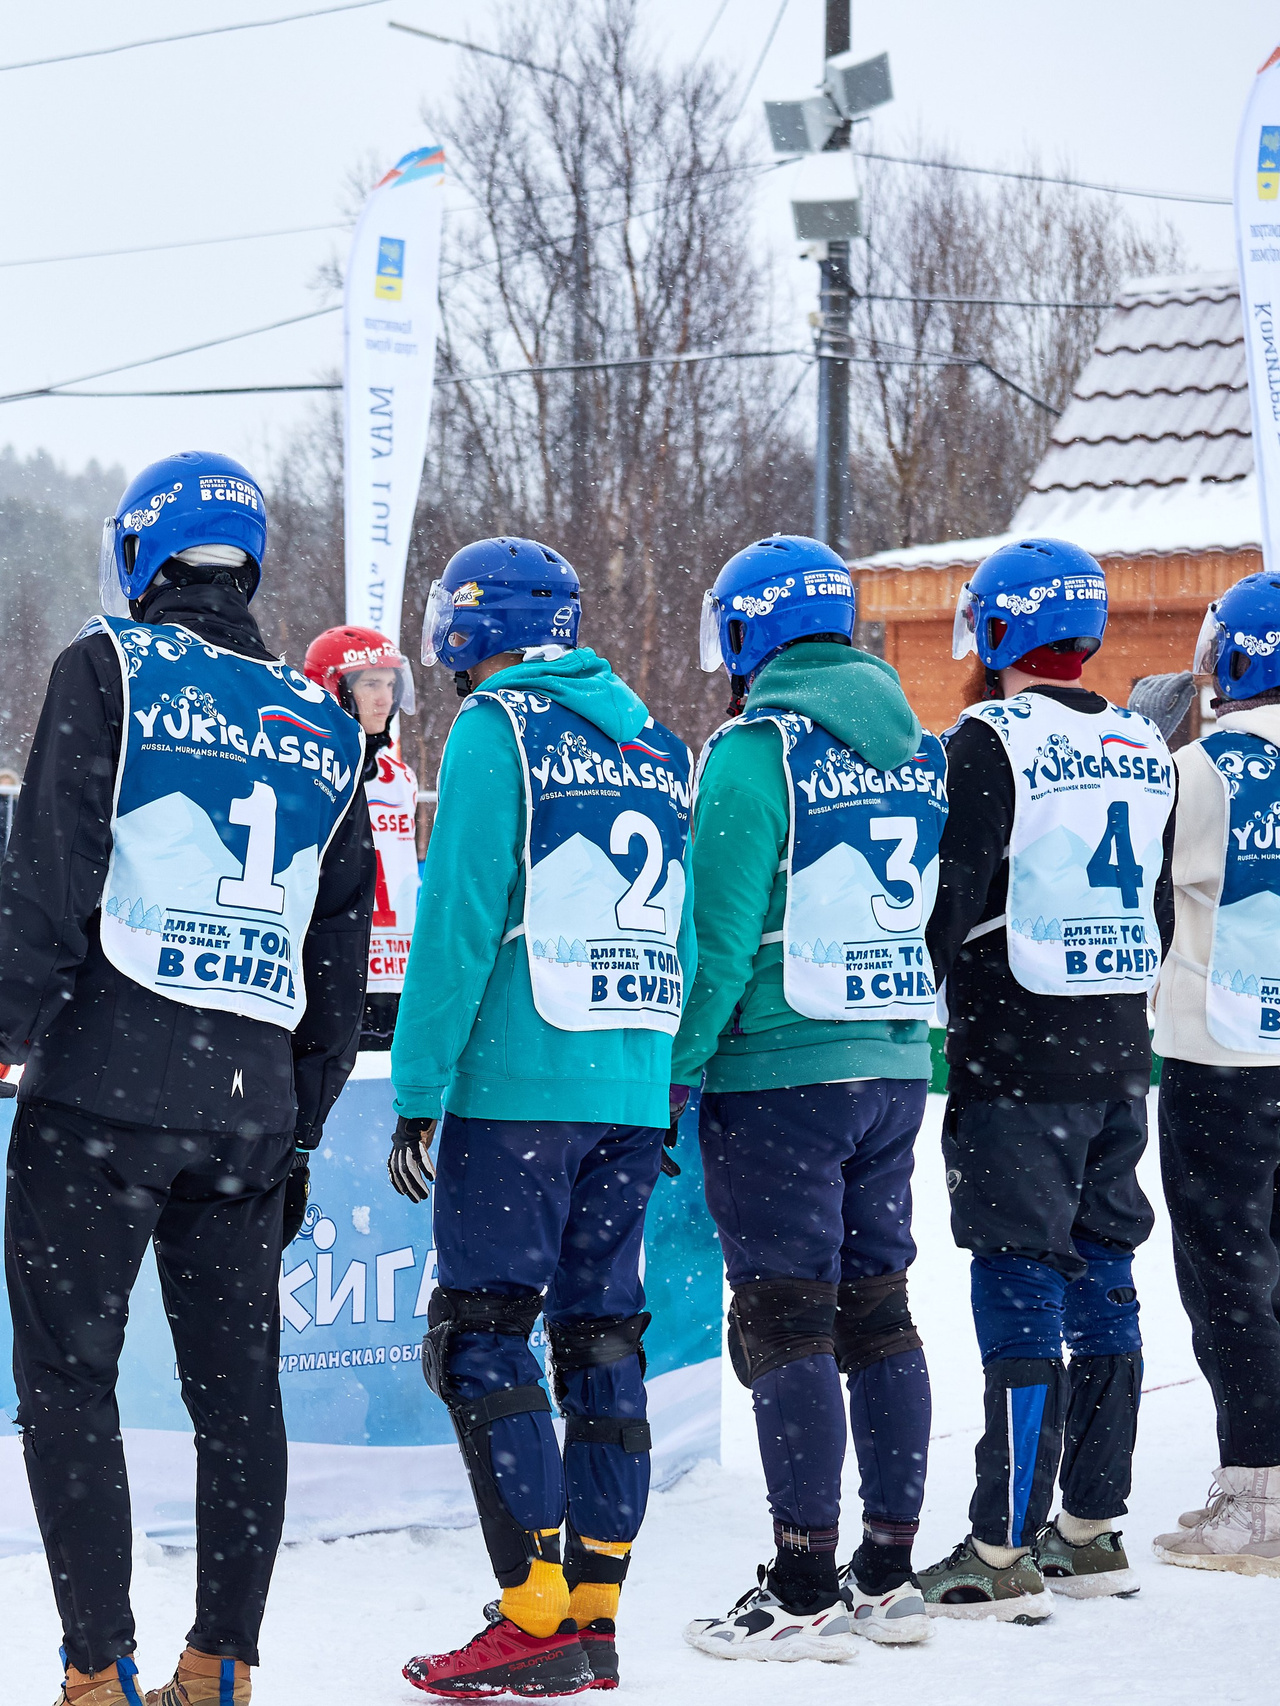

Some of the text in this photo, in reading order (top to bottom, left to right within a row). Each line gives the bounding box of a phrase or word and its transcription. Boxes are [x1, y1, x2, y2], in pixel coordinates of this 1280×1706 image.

[228, 480, 257, 498] ТОЛК
[201, 489, 258, 510] В СНЕГЕ
[806, 584, 852, 598] В СНЕГЕ
[1065, 588, 1106, 601] В СНЕГЕ
[133, 699, 351, 793] YUKIGASSEN
[175, 745, 218, 758] MURMANSK
[220, 751, 247, 764] REGION
[1022, 748, 1172, 789] YUKIGASSEN
[531, 748, 690, 809] YUKIGASSEN
[566, 790, 600, 798] MURMANSK
[600, 789, 621, 797] REGION
[862, 798, 882, 806] REGION
[217, 781, 286, 916] 1
[1086, 801, 1144, 909] 4
[609, 810, 666, 935] 2
[869, 816, 923, 933] 3
[163, 918, 231, 938] ДЛЯ ТЕХ,
[1064, 925, 1117, 937] ДЛЯ ТЕХ,
[162, 932, 231, 949] КТО ЗНАЕТ
[1064, 937, 1117, 946] КТО ЗНАЕТ
[157, 947, 185, 978] В
[590, 947, 616, 960] ДЛЯ
[846, 949, 869, 962] ДЛЯ
[1065, 950, 1088, 975] В
[591, 961, 639, 970] КТО ЗНАЕТ
[846, 960, 893, 971] КТО ЗНАЕТ
[591, 974, 681, 1009] В СНЕГЕ
[846, 975, 866, 1002] В
[1261, 985, 1280, 996] ДЛ
